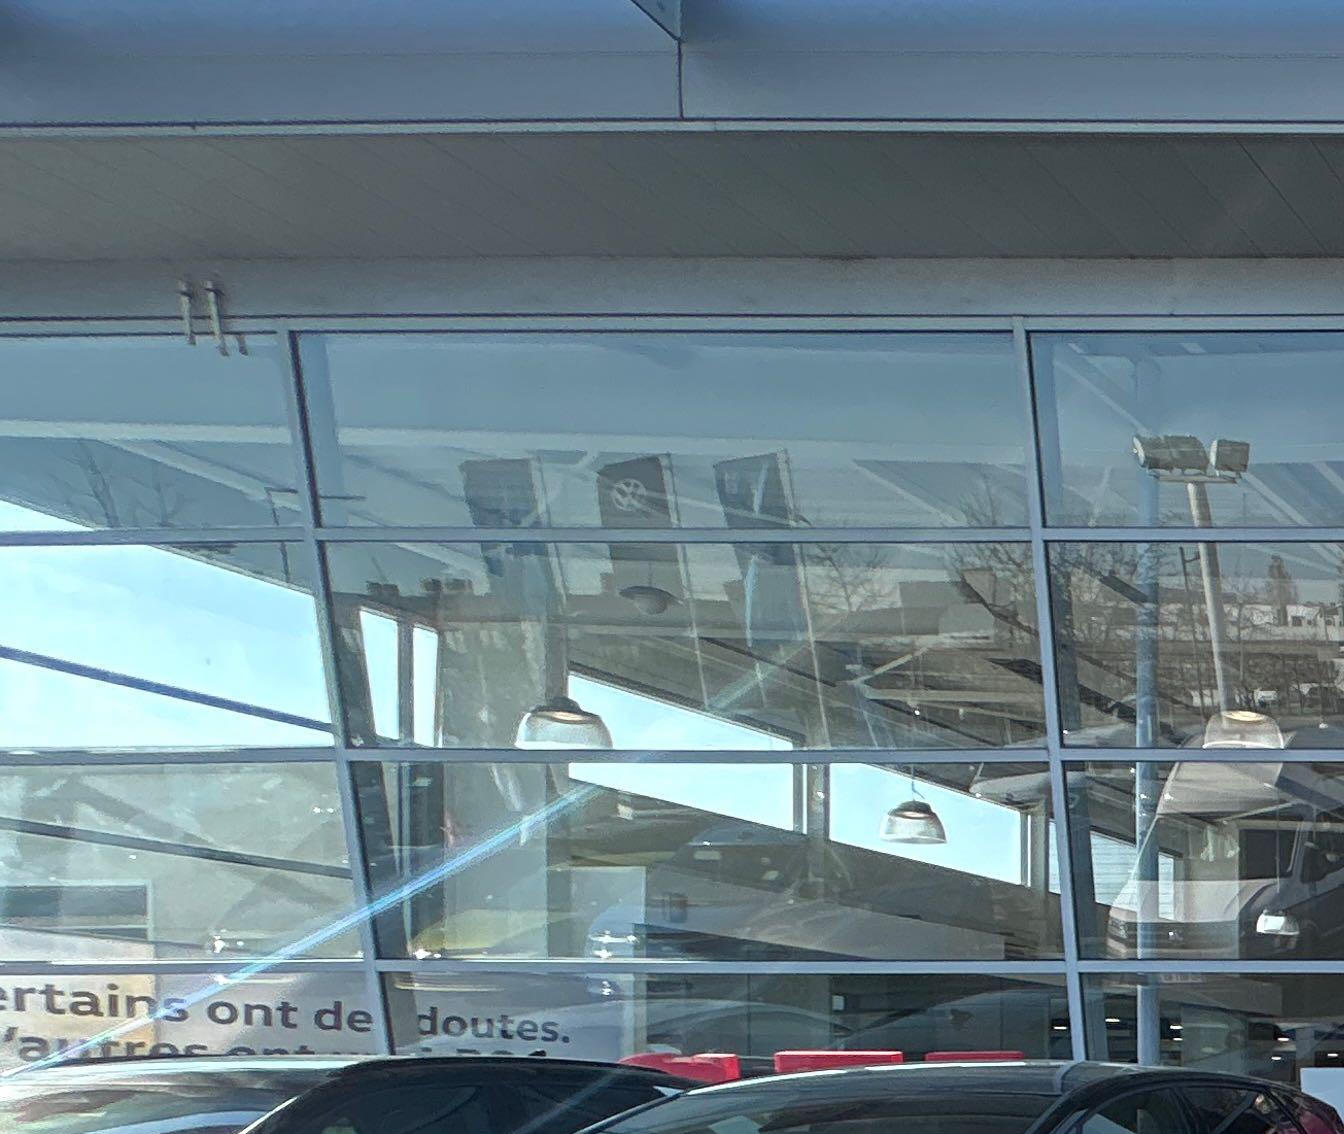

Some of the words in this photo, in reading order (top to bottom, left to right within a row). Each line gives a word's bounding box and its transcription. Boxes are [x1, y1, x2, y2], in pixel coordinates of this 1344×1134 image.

[0, 983, 189, 1022] rtains
[207, 1001, 298, 1029] ont
[314, 1001, 373, 1033] de
[417, 1006, 570, 1043] doutes.
